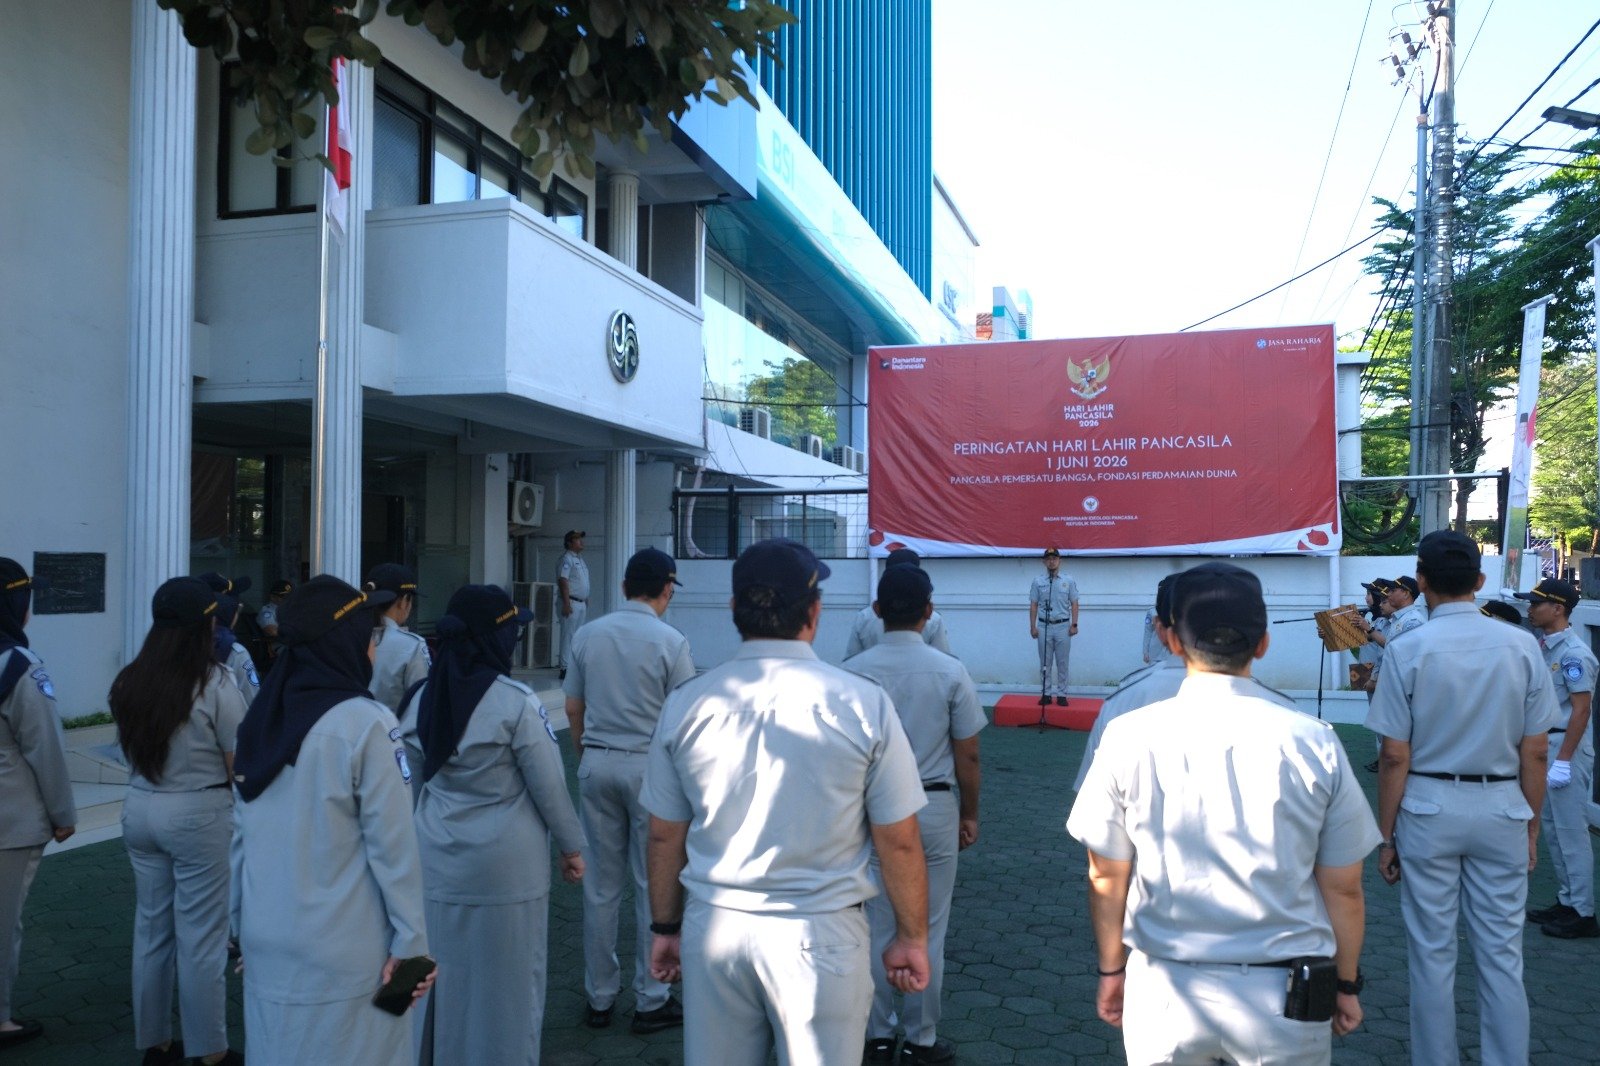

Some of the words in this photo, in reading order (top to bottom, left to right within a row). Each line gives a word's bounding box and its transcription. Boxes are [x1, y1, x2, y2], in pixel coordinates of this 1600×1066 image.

[772, 129, 795, 192] BSI
[1268, 339, 1285, 347] JASA
[1286, 337, 1322, 345] RAHARJA
[1063, 405, 1085, 413] HARI
[1087, 403, 1114, 412] LAHIR
[1064, 411, 1113, 420] PANCASILA
[953, 441, 1048, 455] PERINGATAN
[1052, 440, 1087, 452] HARI
[1092, 438, 1137, 451] LAHIR
[1141, 434, 1233, 450] PANCASILA
[1047, 457, 1051, 469] 1
[1056, 456, 1088, 471] JUNI
[1093, 455, 1128, 468] 2026
[950, 475, 1000, 484] PANCASILA
[1002, 474, 1054, 483] PEMERSATU
[1056, 473, 1096, 482] BANGSA,
[1097, 472, 1140, 480] FONDASI
[1141, 470, 1205, 480] PERDAMAIAN
[1206, 469, 1237, 478] DUNIA
